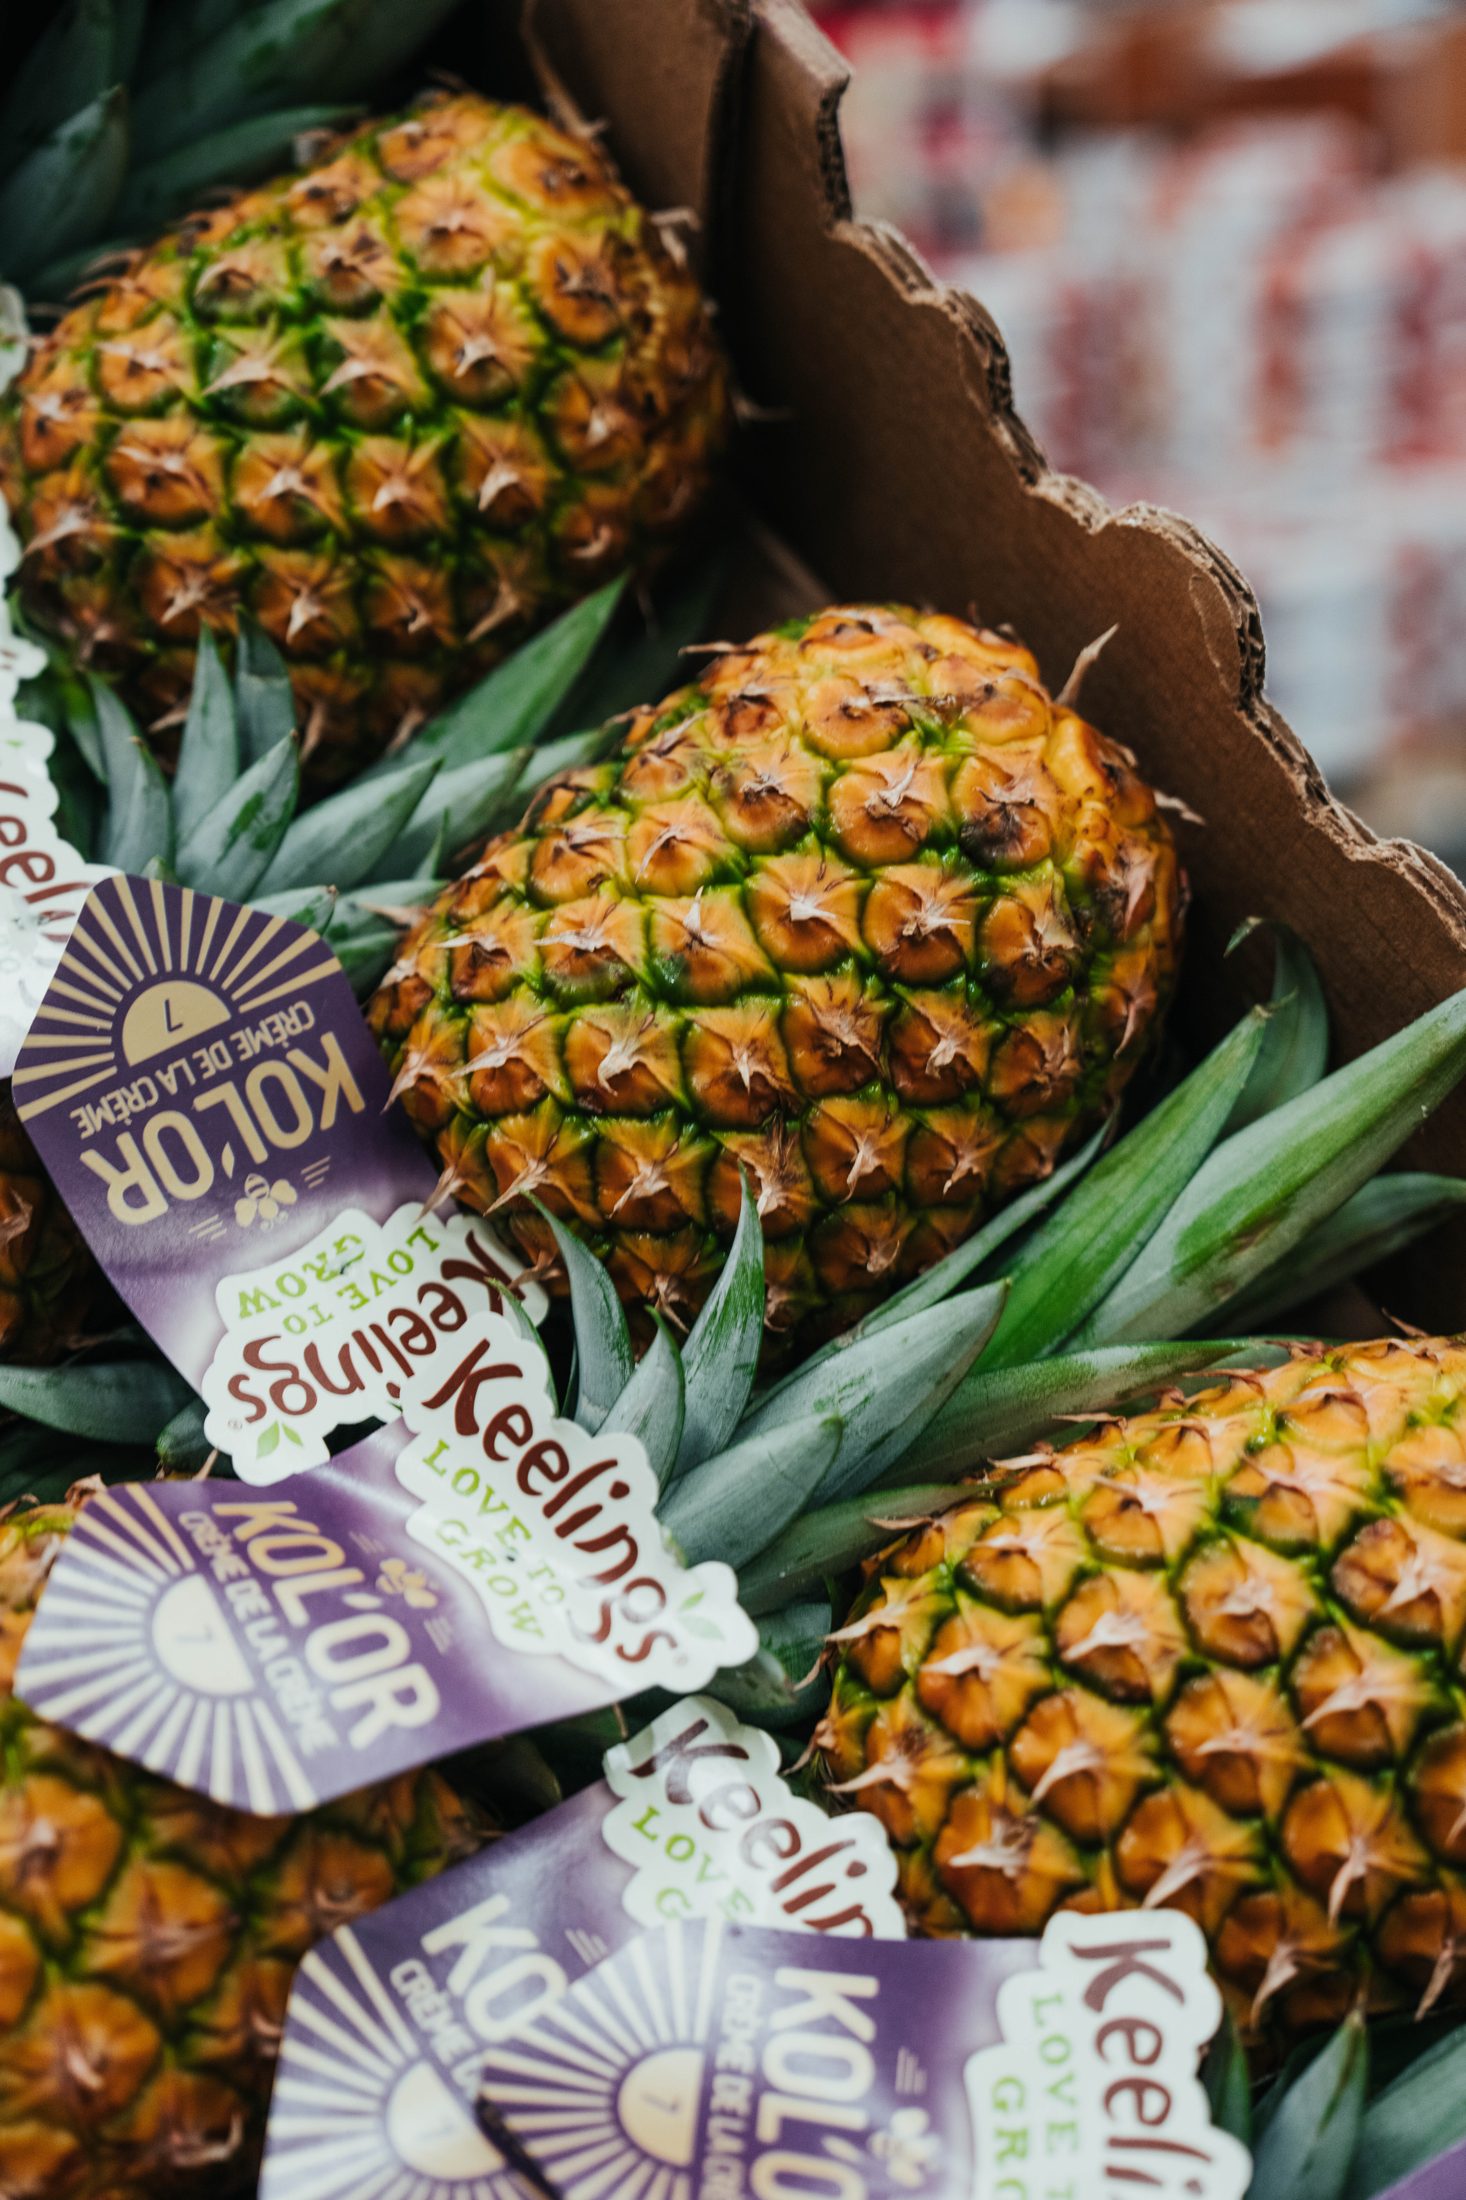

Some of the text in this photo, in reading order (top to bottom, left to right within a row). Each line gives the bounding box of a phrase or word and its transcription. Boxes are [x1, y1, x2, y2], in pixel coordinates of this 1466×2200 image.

[69, 1000, 316, 1140] CRÈME DE LA CRÈME
[162, 998, 184, 1033] 7
[79, 1031, 367, 1226] KOL'OR
[227, 1229, 527, 1423] Keelings
[238, 1234, 366, 1319] GROW
[282, 1226, 440, 1335] LOVE TO
[421, 1337, 678, 1663] Keelings
[421, 1438, 566, 1605] LOVE TO
[224, 1577, 273, 1622] DE
[243, 1615, 290, 1663] LA
[435, 1519, 545, 1639] GROW
[632, 1805, 756, 1922] LOVE
[1030, 1989, 1079, 2158] LOVE
